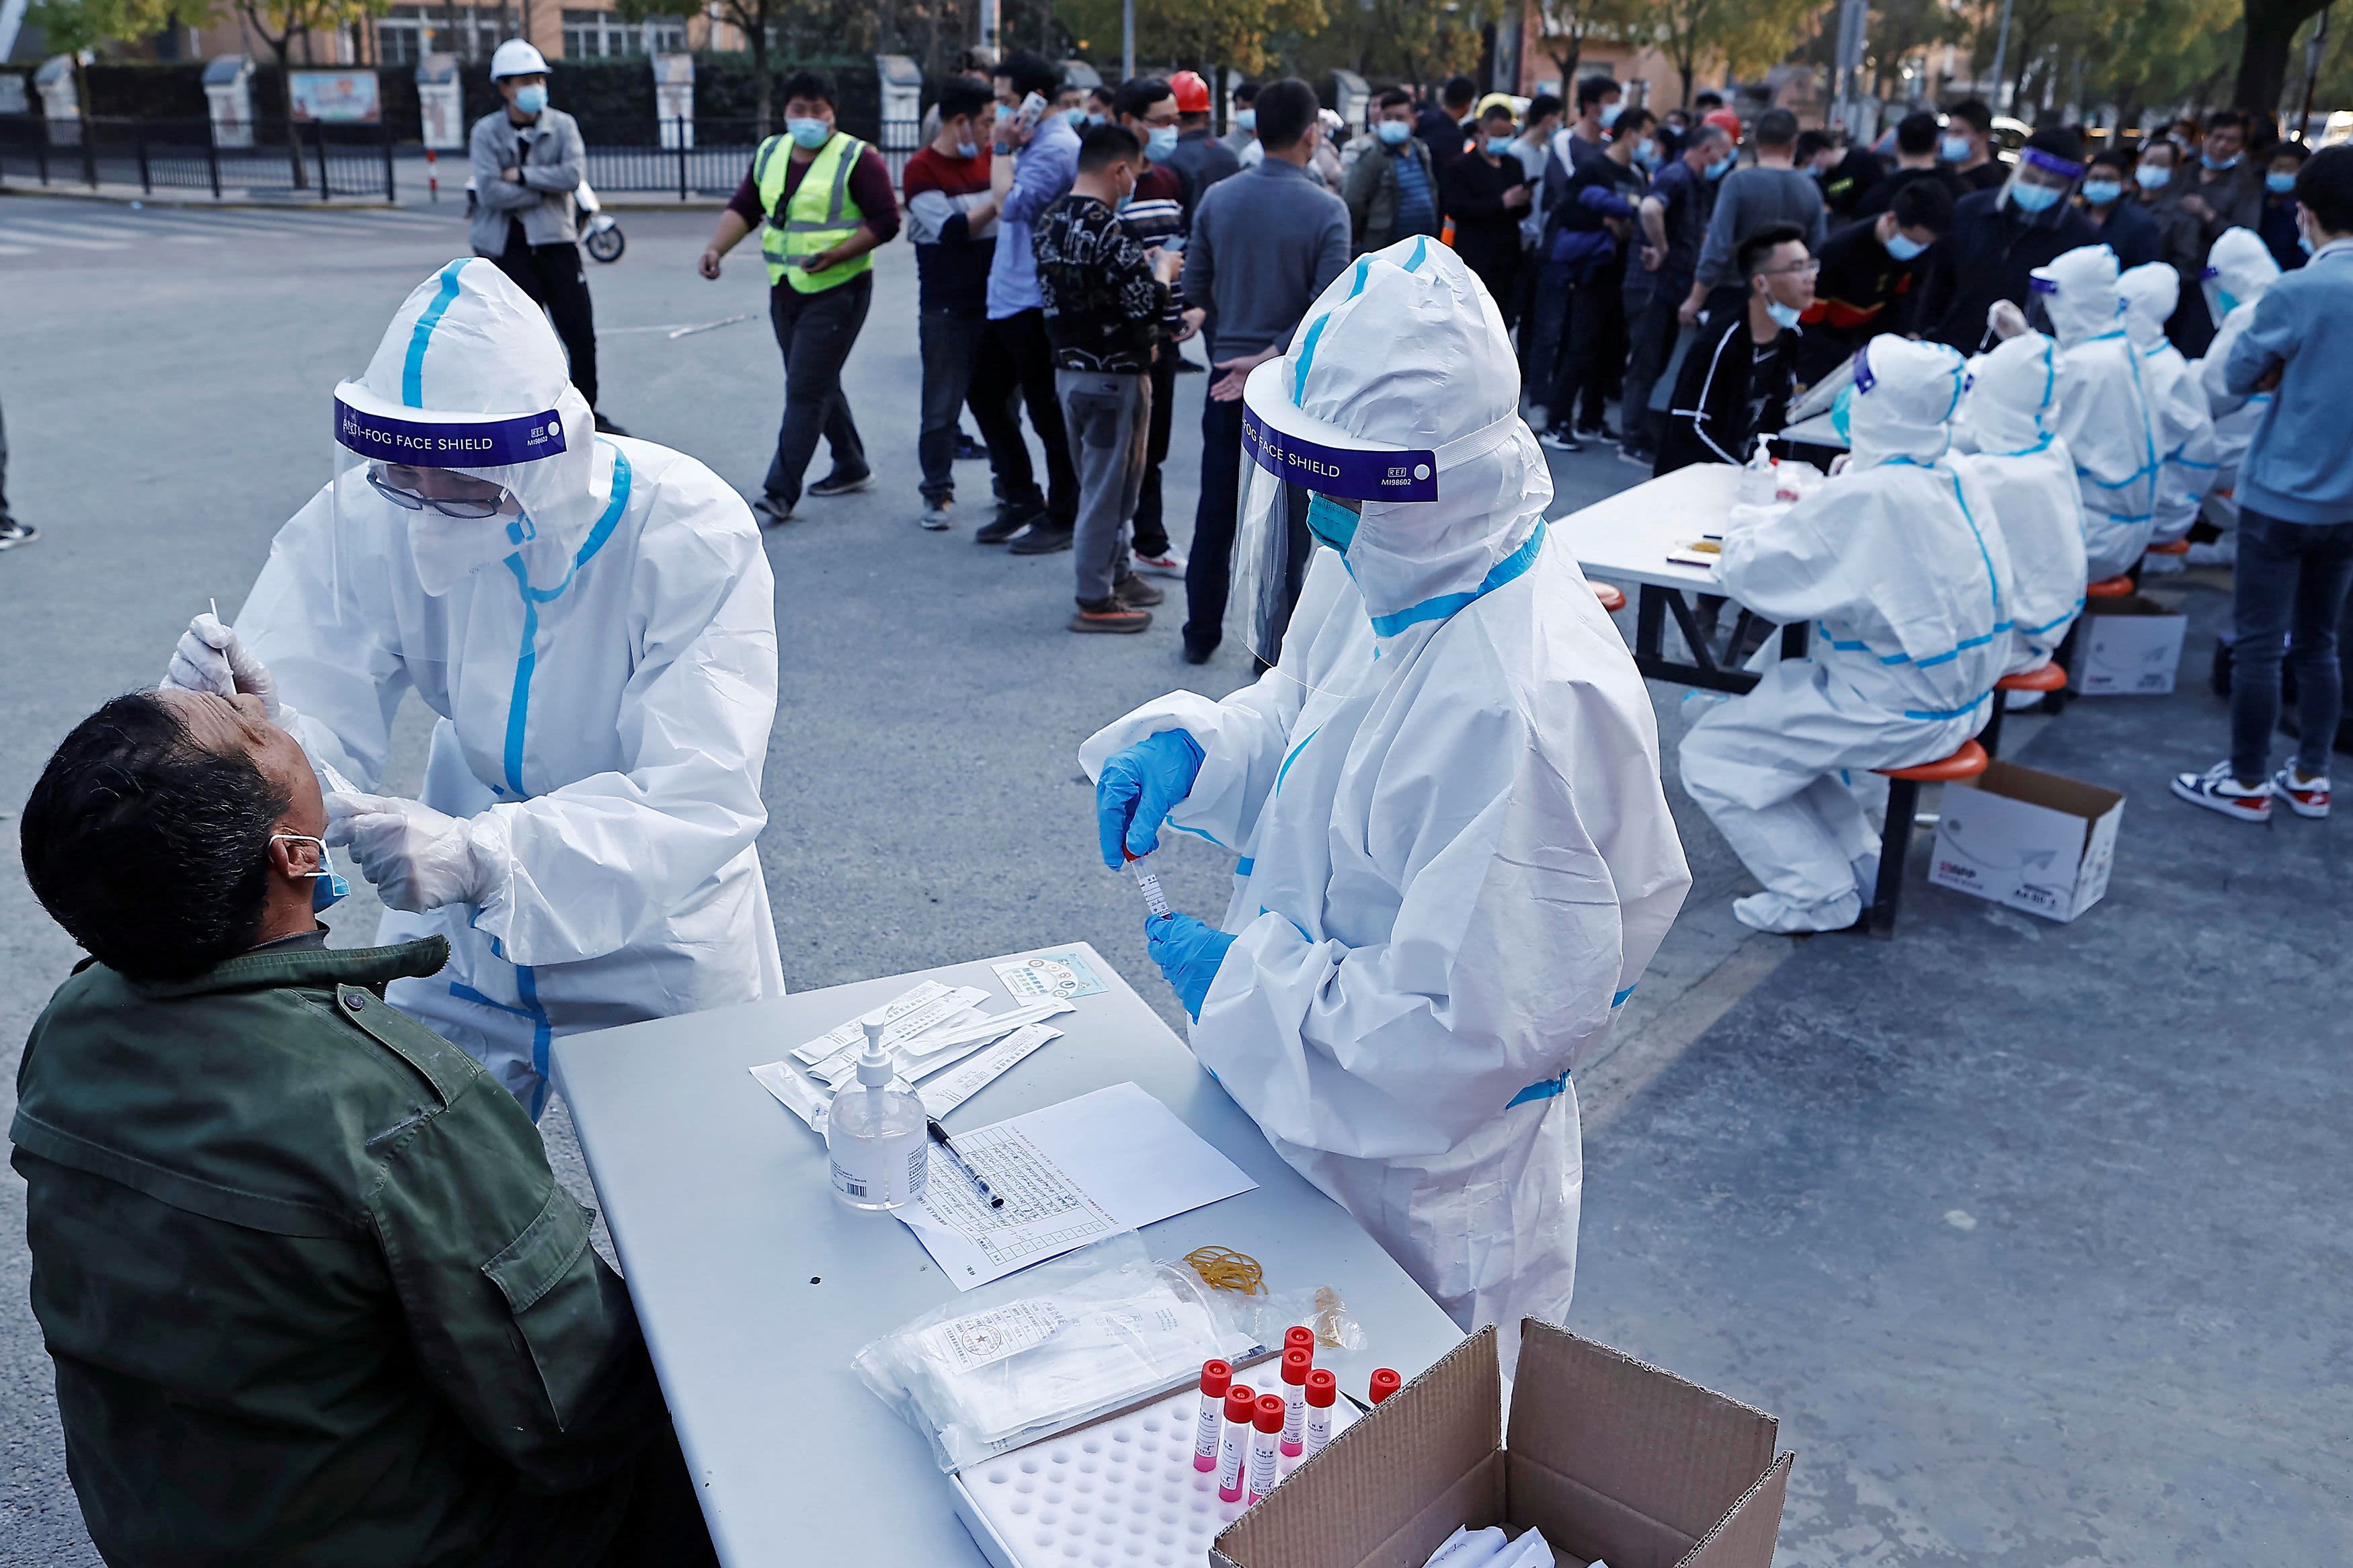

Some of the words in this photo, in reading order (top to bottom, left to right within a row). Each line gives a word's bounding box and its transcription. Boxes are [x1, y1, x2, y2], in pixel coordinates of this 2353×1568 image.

[343, 418, 391, 444] ANTI-FOG
[397, 435, 432, 450] FACE
[438, 438, 493, 450] SHIELD
[532, 427, 543, 437] REF
[1259, 436, 1283, 461] FACE
[1289, 453, 1340, 477] SHIELD
